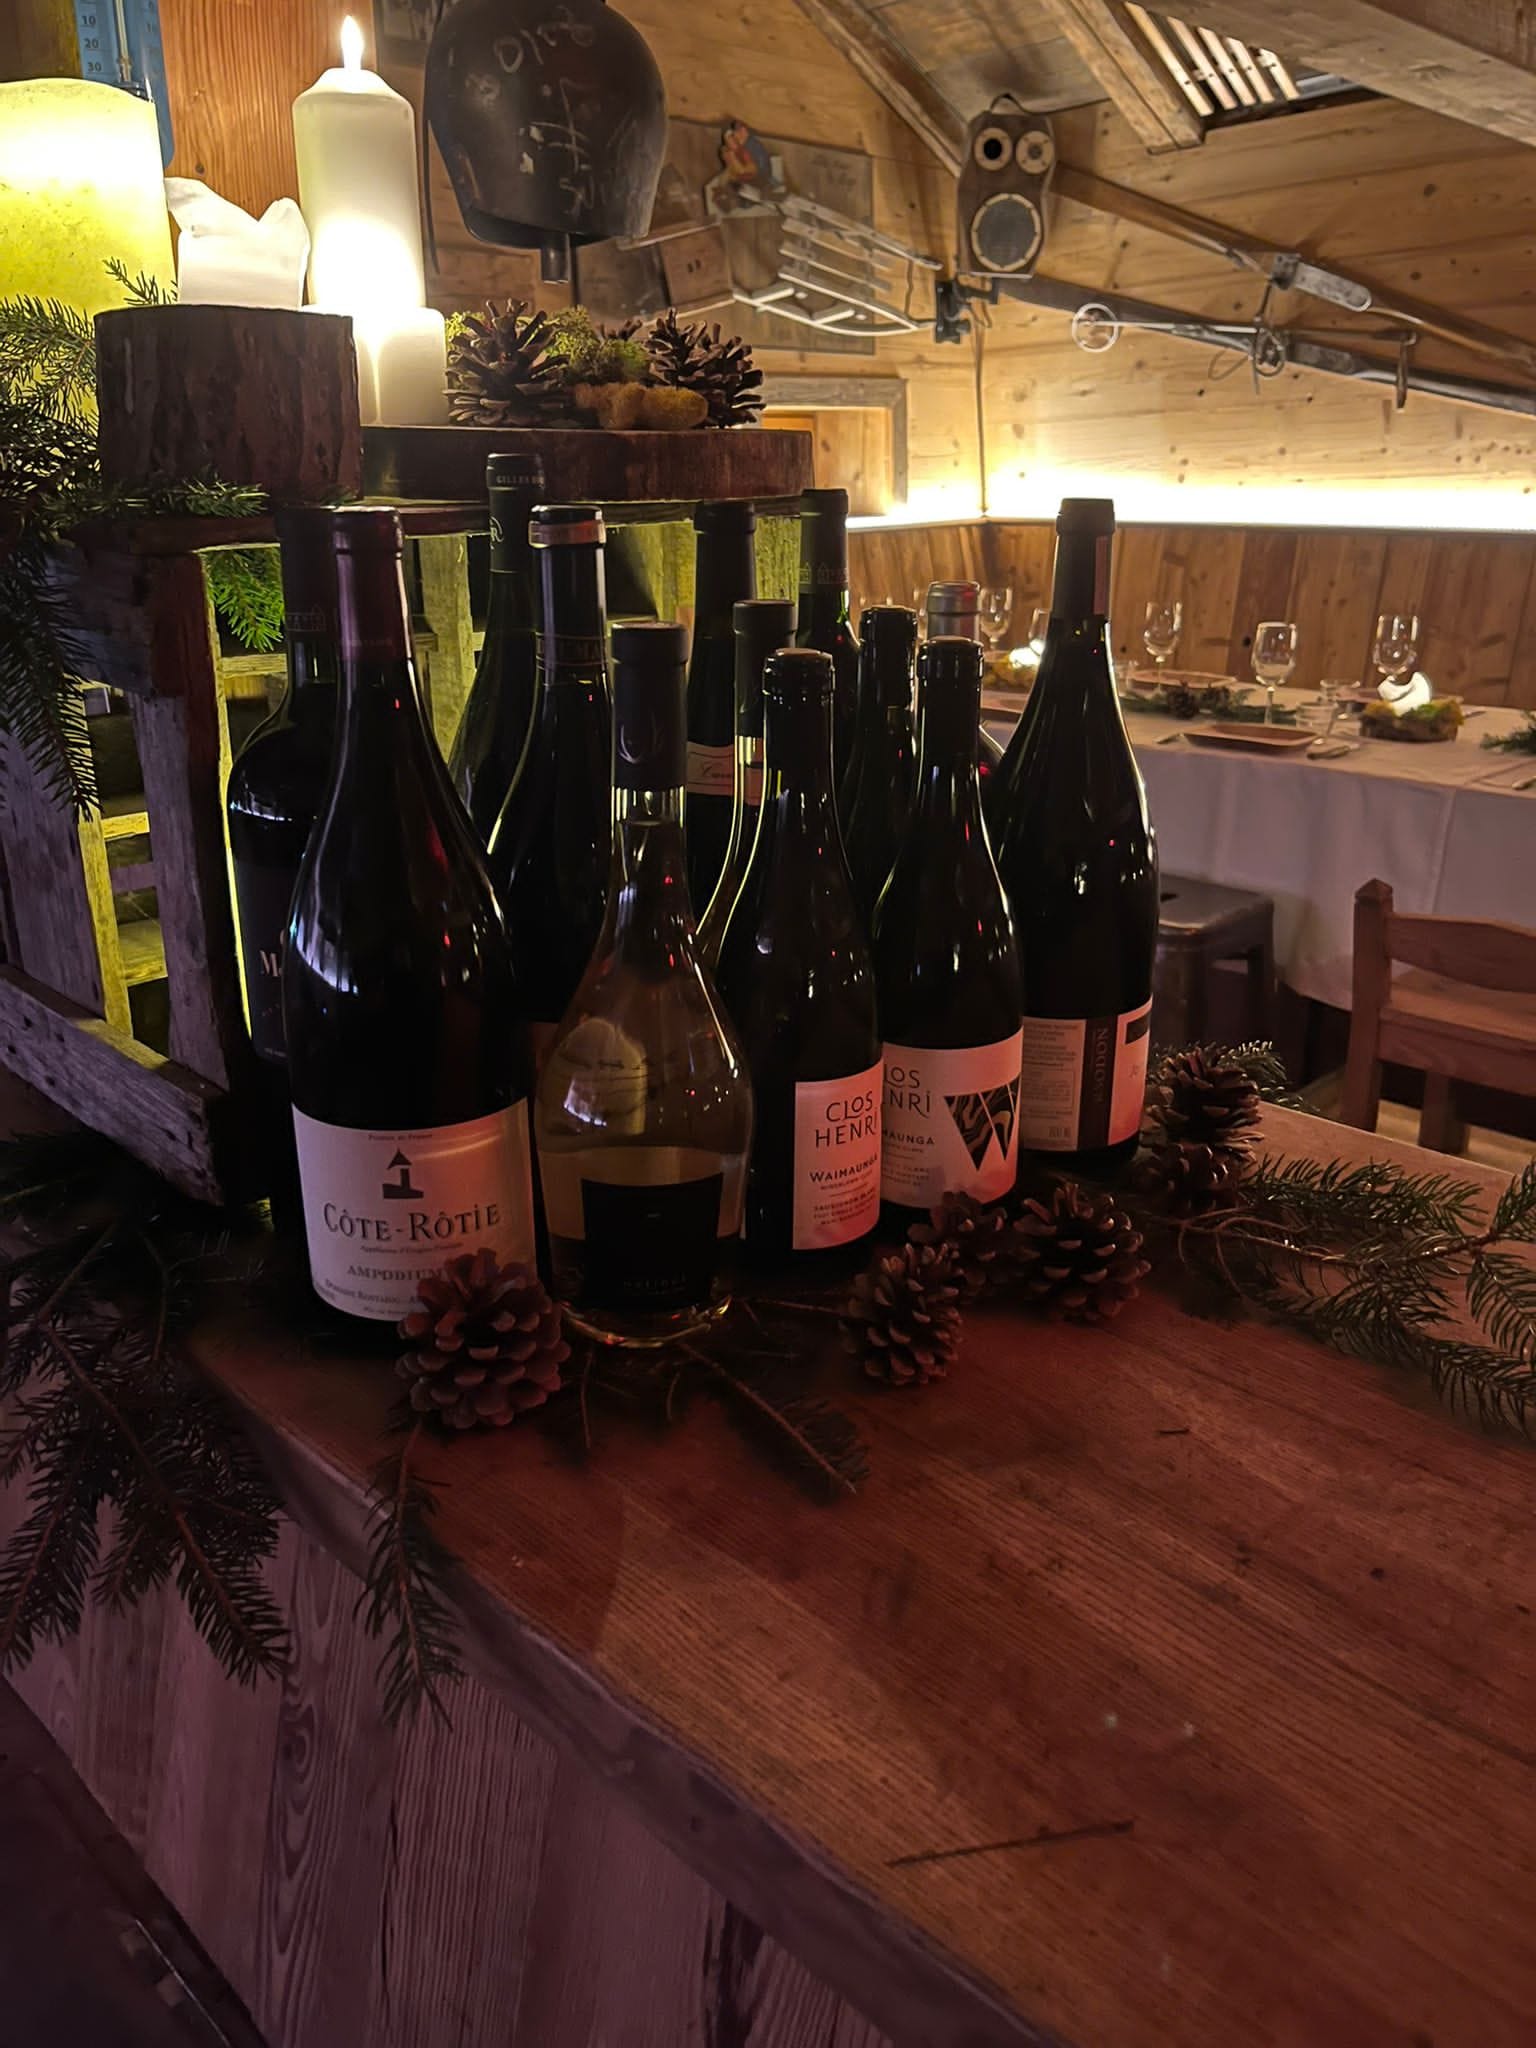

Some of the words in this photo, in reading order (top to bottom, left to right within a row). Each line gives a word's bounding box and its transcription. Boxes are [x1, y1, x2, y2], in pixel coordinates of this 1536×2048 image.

[82, 15, 97, 25] 10
[84, 38, 99, 49] 20
[87, 62, 102, 72] 30
[883, 1063, 920, 1089] LOS
[826, 1090, 873, 1123] CLOS
[815, 1107, 878, 1148] HENRI
[323, 1202, 501, 1242] CÔTE-RÔTIE
